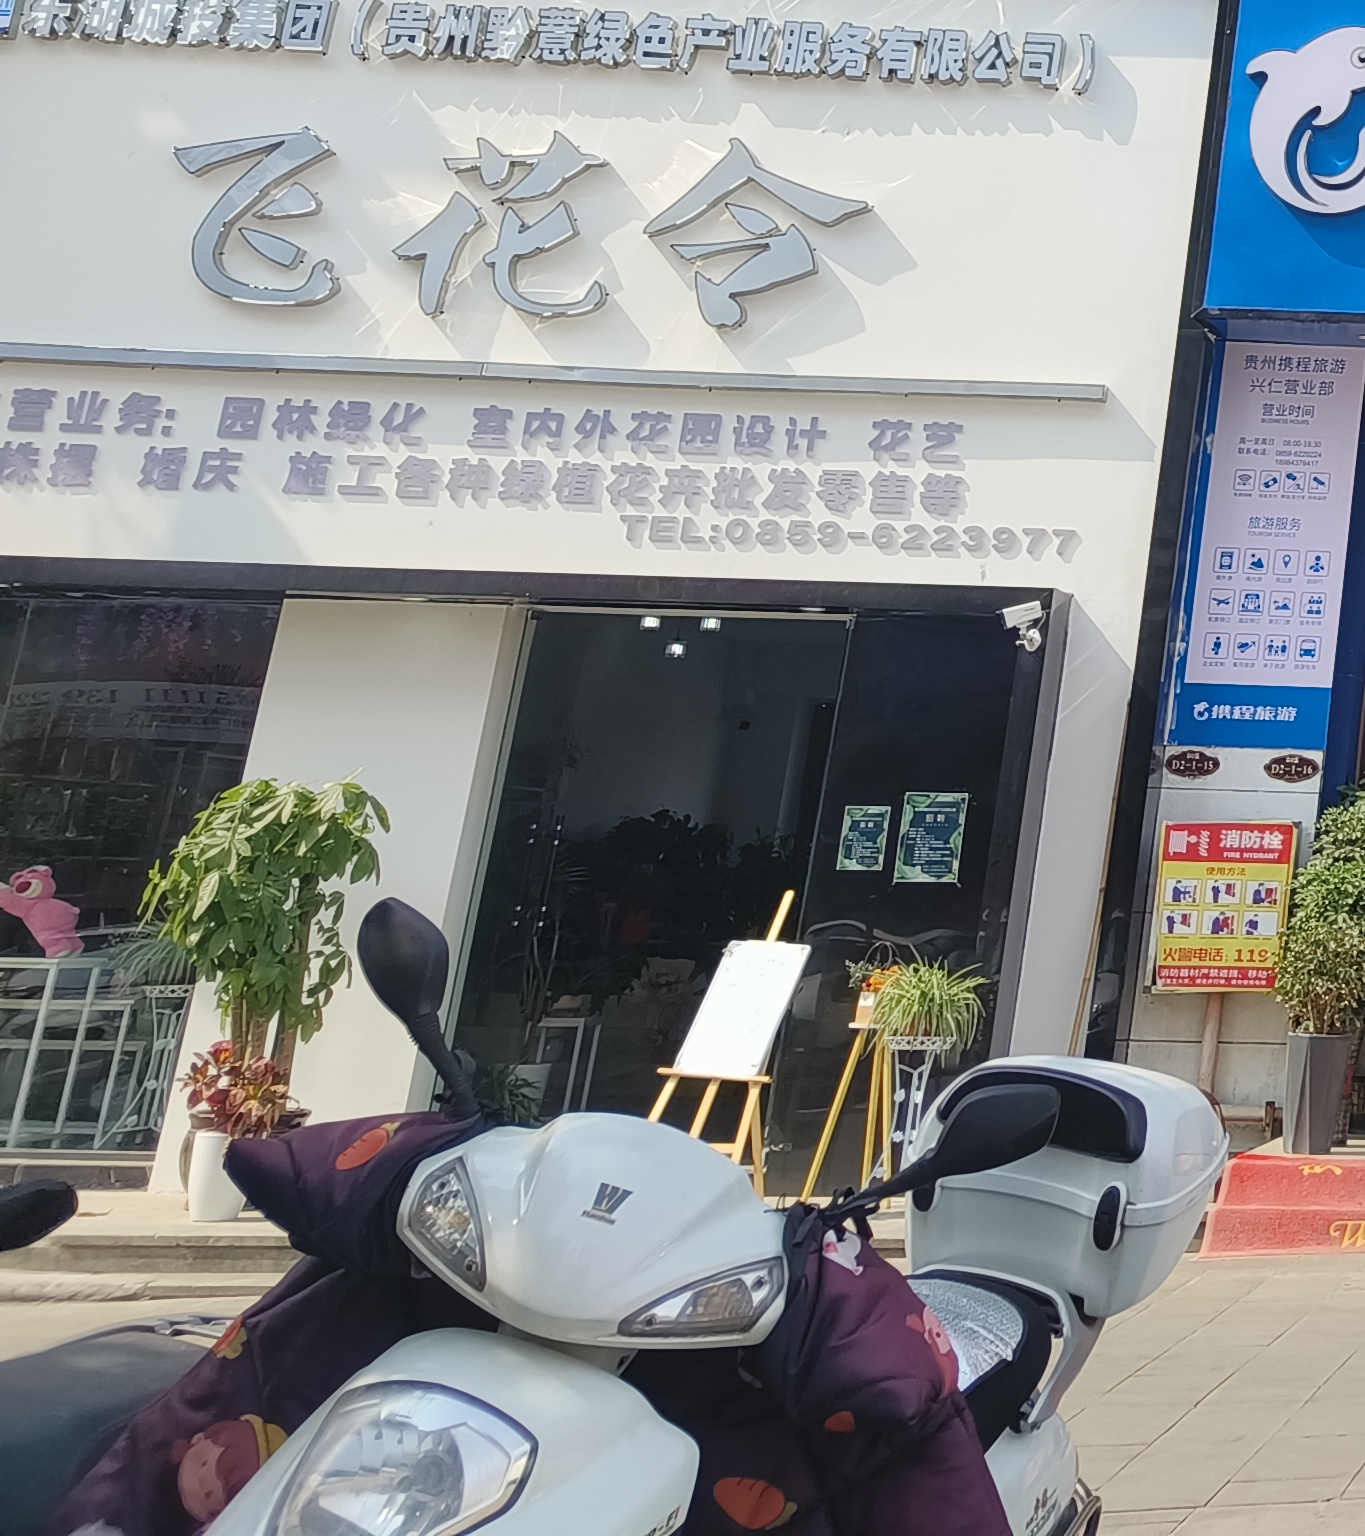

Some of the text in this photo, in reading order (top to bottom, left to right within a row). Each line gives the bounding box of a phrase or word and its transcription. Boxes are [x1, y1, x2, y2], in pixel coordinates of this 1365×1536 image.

[171, 125, 875, 329] 飞花令
[1243, 355, 1347, 374] 贵州携程旅游
[1249, 377, 1335, 396] 兴仁营业部
[1261, 403, 1315, 418] 营业时间
[217, 396, 427, 447] 园林绿化
[470, 405, 828, 458] 室内外花园设计
[868, 419, 965, 465] 花艺
[137, 446, 243, 493] 婚庆
[1247, 516, 1302, 532] 旅游服务
[1210, 704, 1298, 722] 携程旅游
[1171, 760, 1214, 771] D2-1-15
[1271, 763, 1313, 775] D2-1-16
[1219, 829, 1284, 850] 消防栓
[1206, 866, 1247, 877] 使用方法
[1234, 948, 1270, 963] 119
